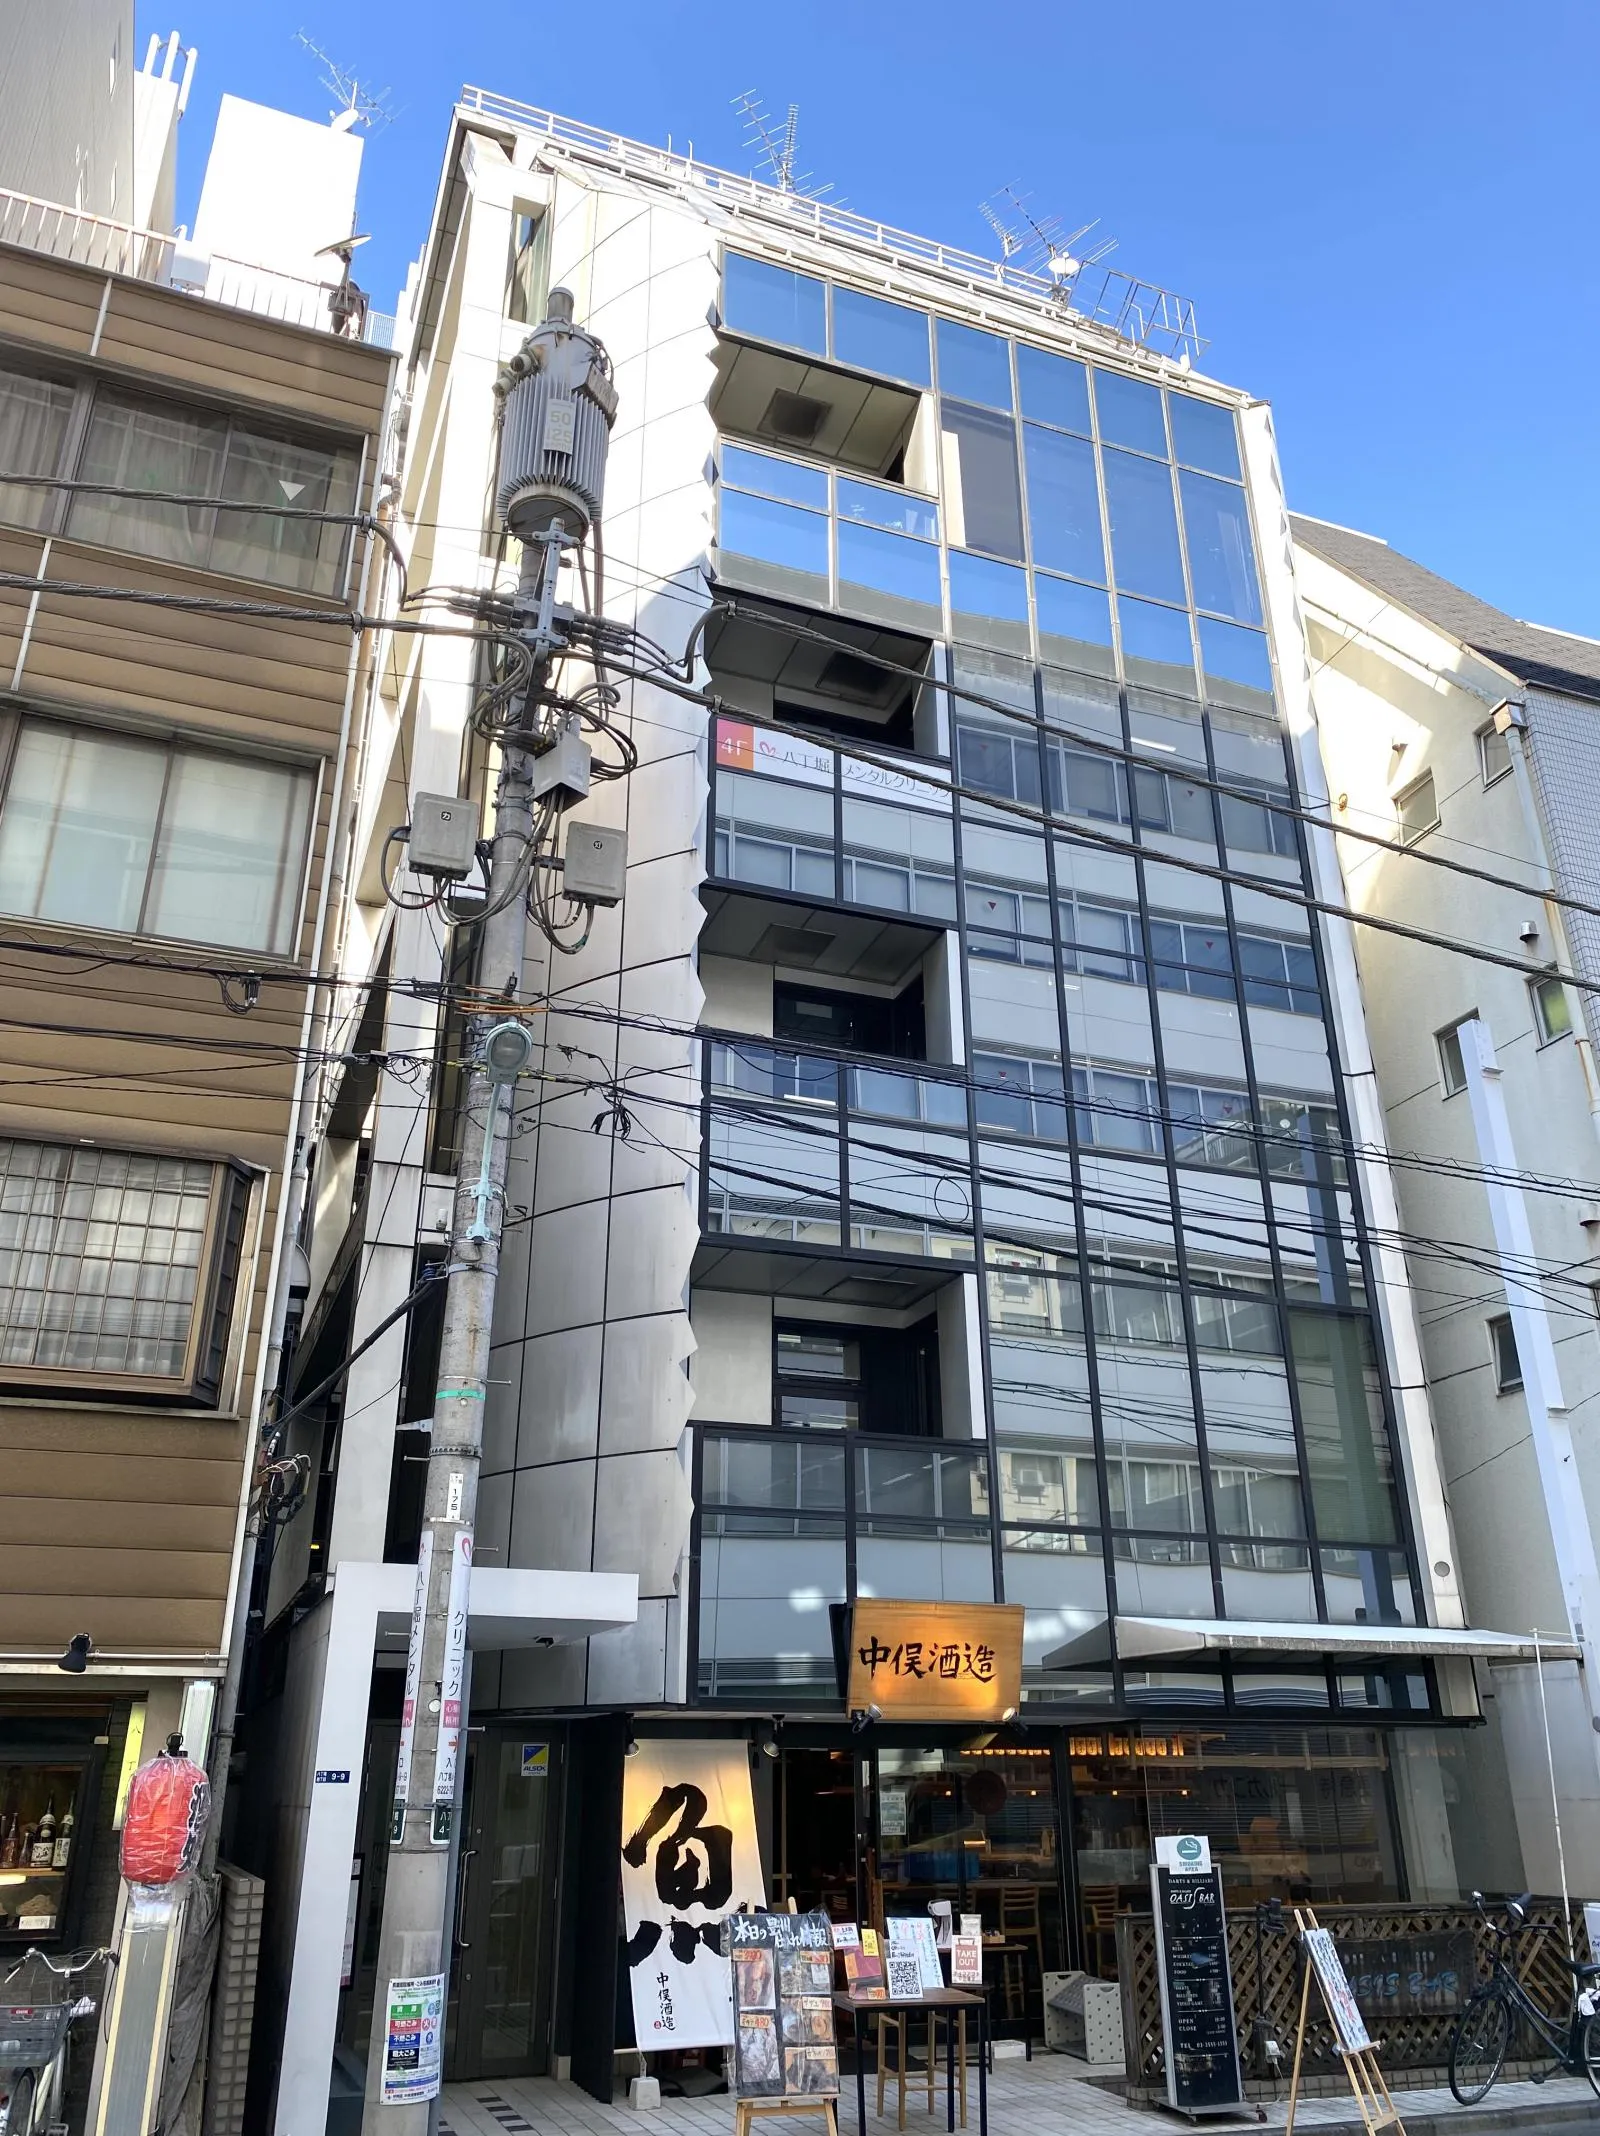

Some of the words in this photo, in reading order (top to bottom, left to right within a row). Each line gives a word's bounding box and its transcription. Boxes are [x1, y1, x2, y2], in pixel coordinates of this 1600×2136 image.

[783, 751, 830, 774] 八丁堀
[449, 1610, 464, 1697] クリニック
[858, 1636, 998, 1684] 中俣酒造
[331, 1772, 346, 1781] 9-9
[1198, 1892, 1215, 1904] BAR
[956, 1949, 977, 1958] TAKE
[958, 1958, 975, 1966] OUT
[656, 1971, 676, 2031] 中俣酒造
